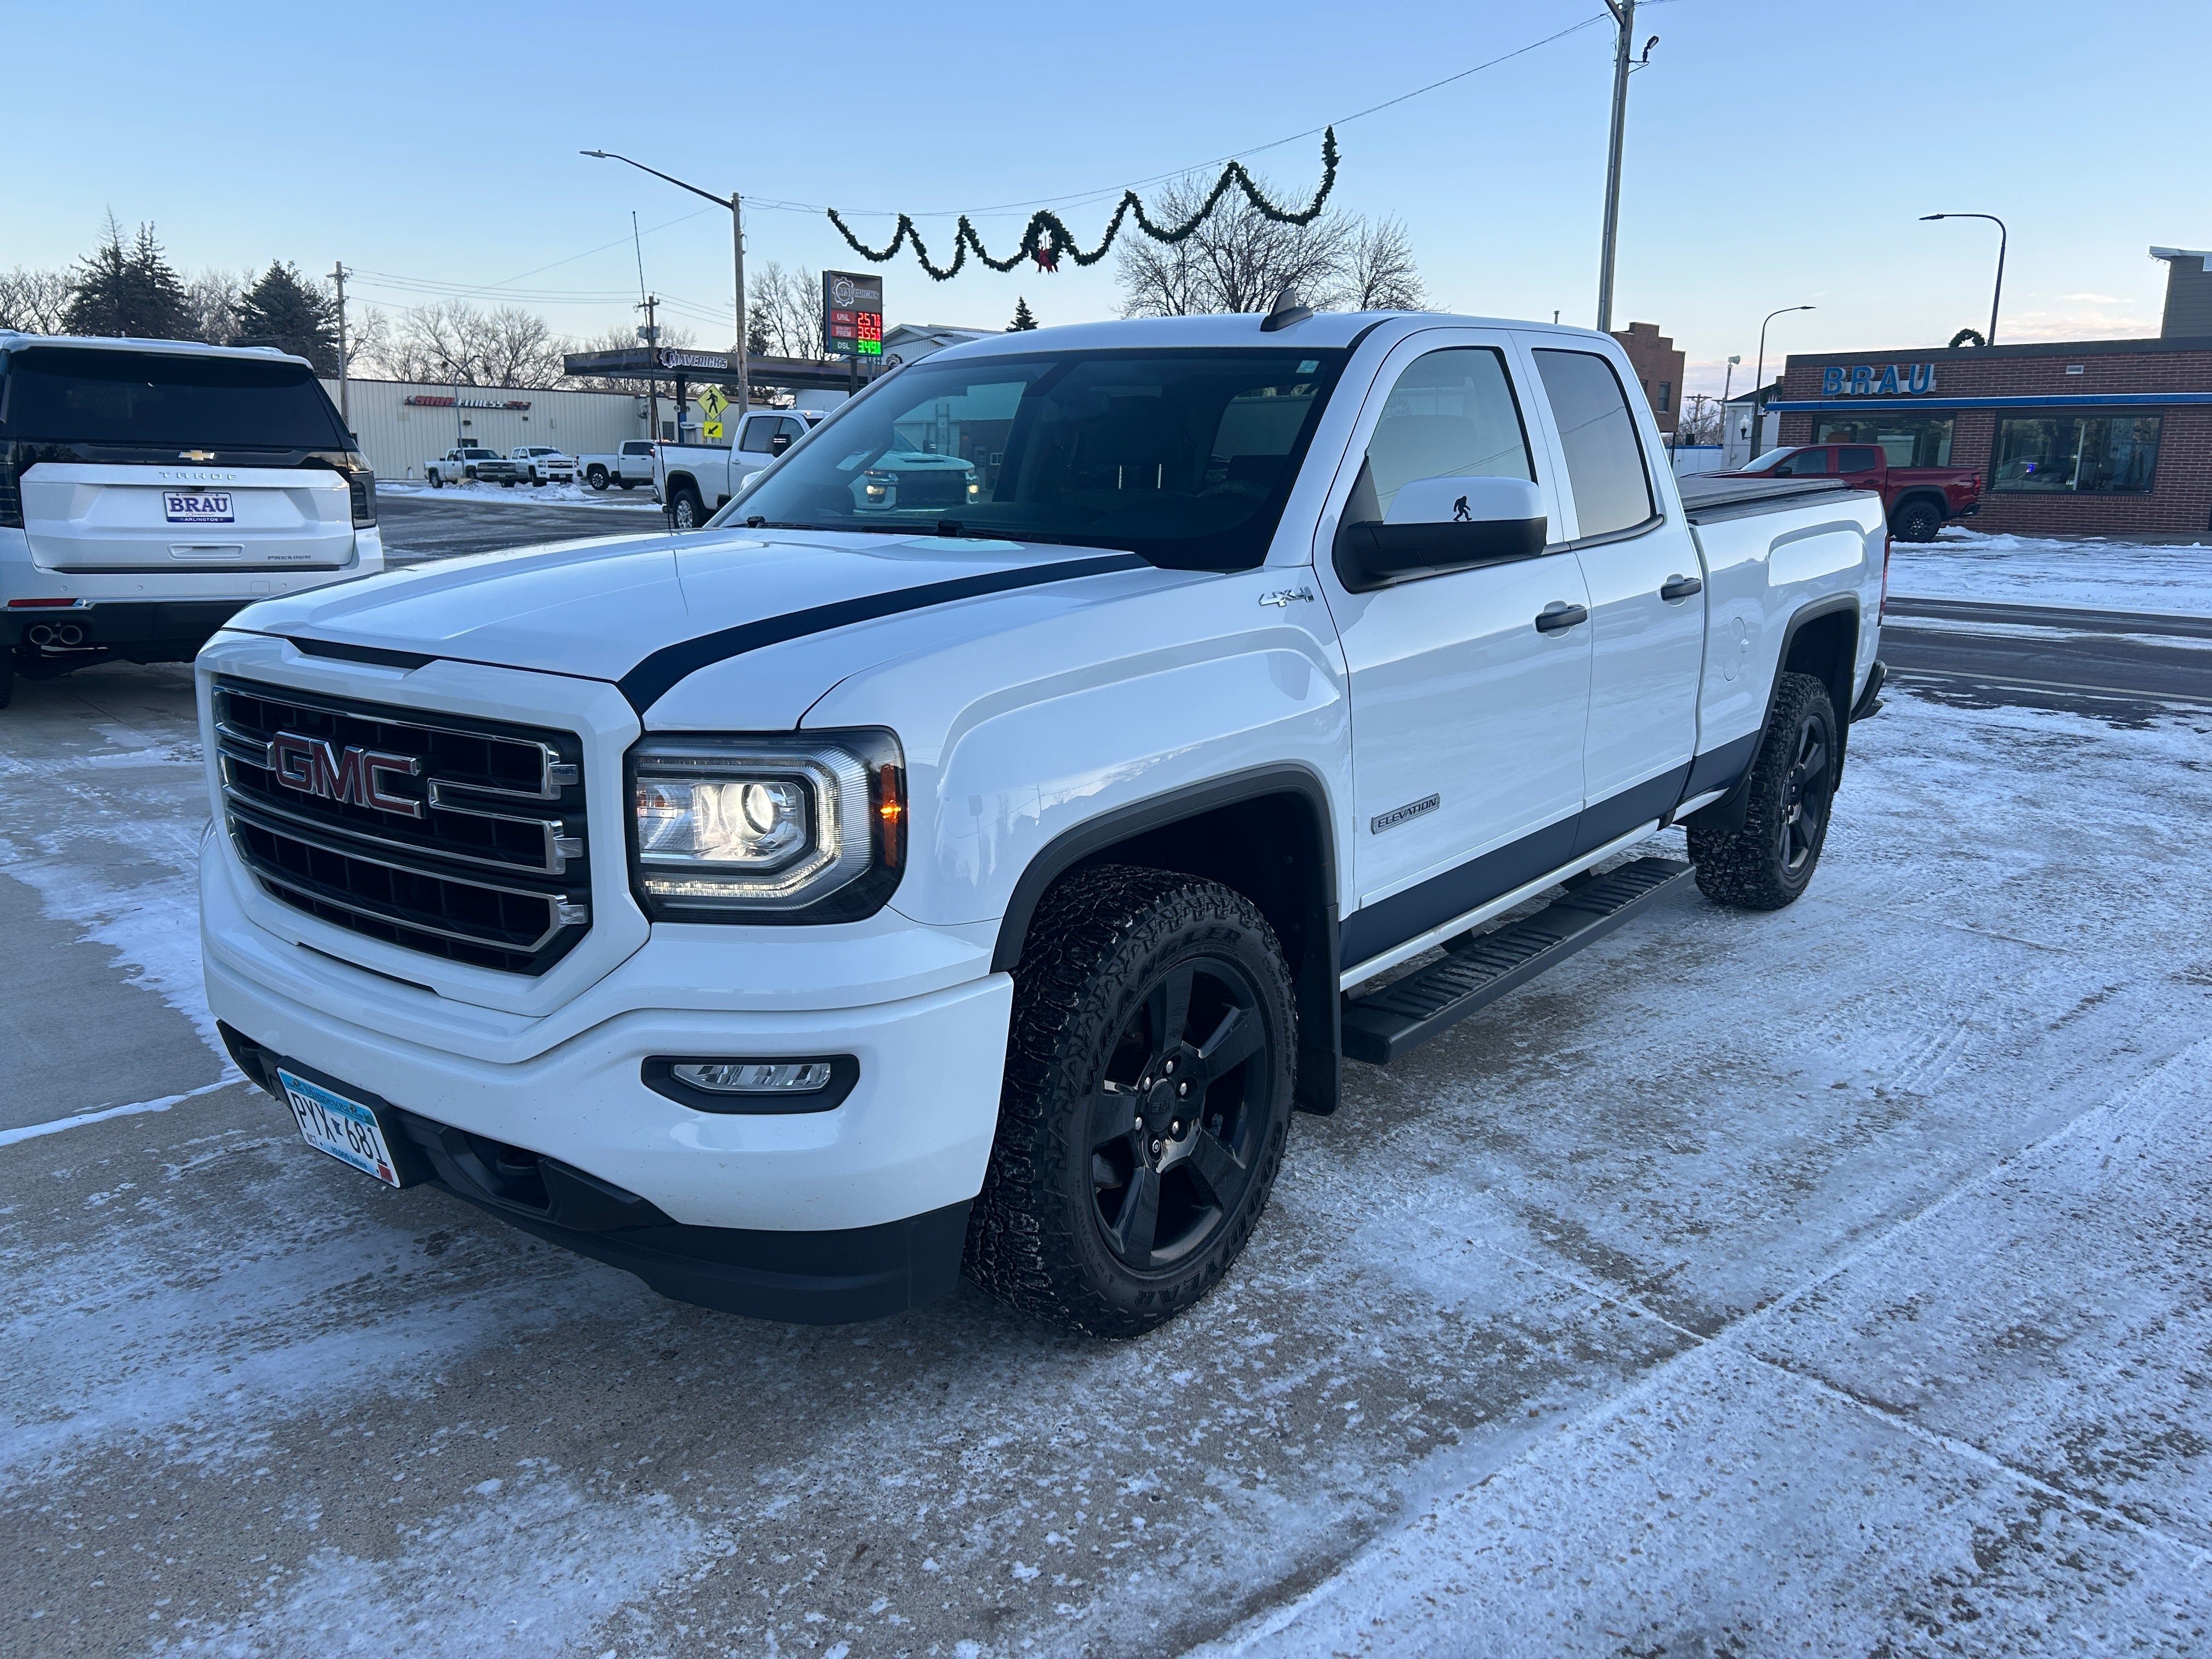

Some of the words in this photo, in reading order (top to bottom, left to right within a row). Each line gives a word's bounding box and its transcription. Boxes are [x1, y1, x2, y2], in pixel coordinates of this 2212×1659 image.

[837, 313, 850, 321] UNL
[837, 341, 850, 349] DSL
[1822, 364, 1934, 396] BRAU
[159, 472, 237, 480] TAHOE
[167, 497, 228, 512] BRAU
[274, 731, 424, 819] GMC
[1378, 797, 1436, 828] ELEVATION
[1082, 926, 1242, 1096] WRANGLER
[302, 1082, 351, 1113] Minnesota
[291, 1092, 337, 1143] PYX
[345, 1116, 388, 1167] 681
[1135, 1120, 1283, 1307] GOODYEAR
